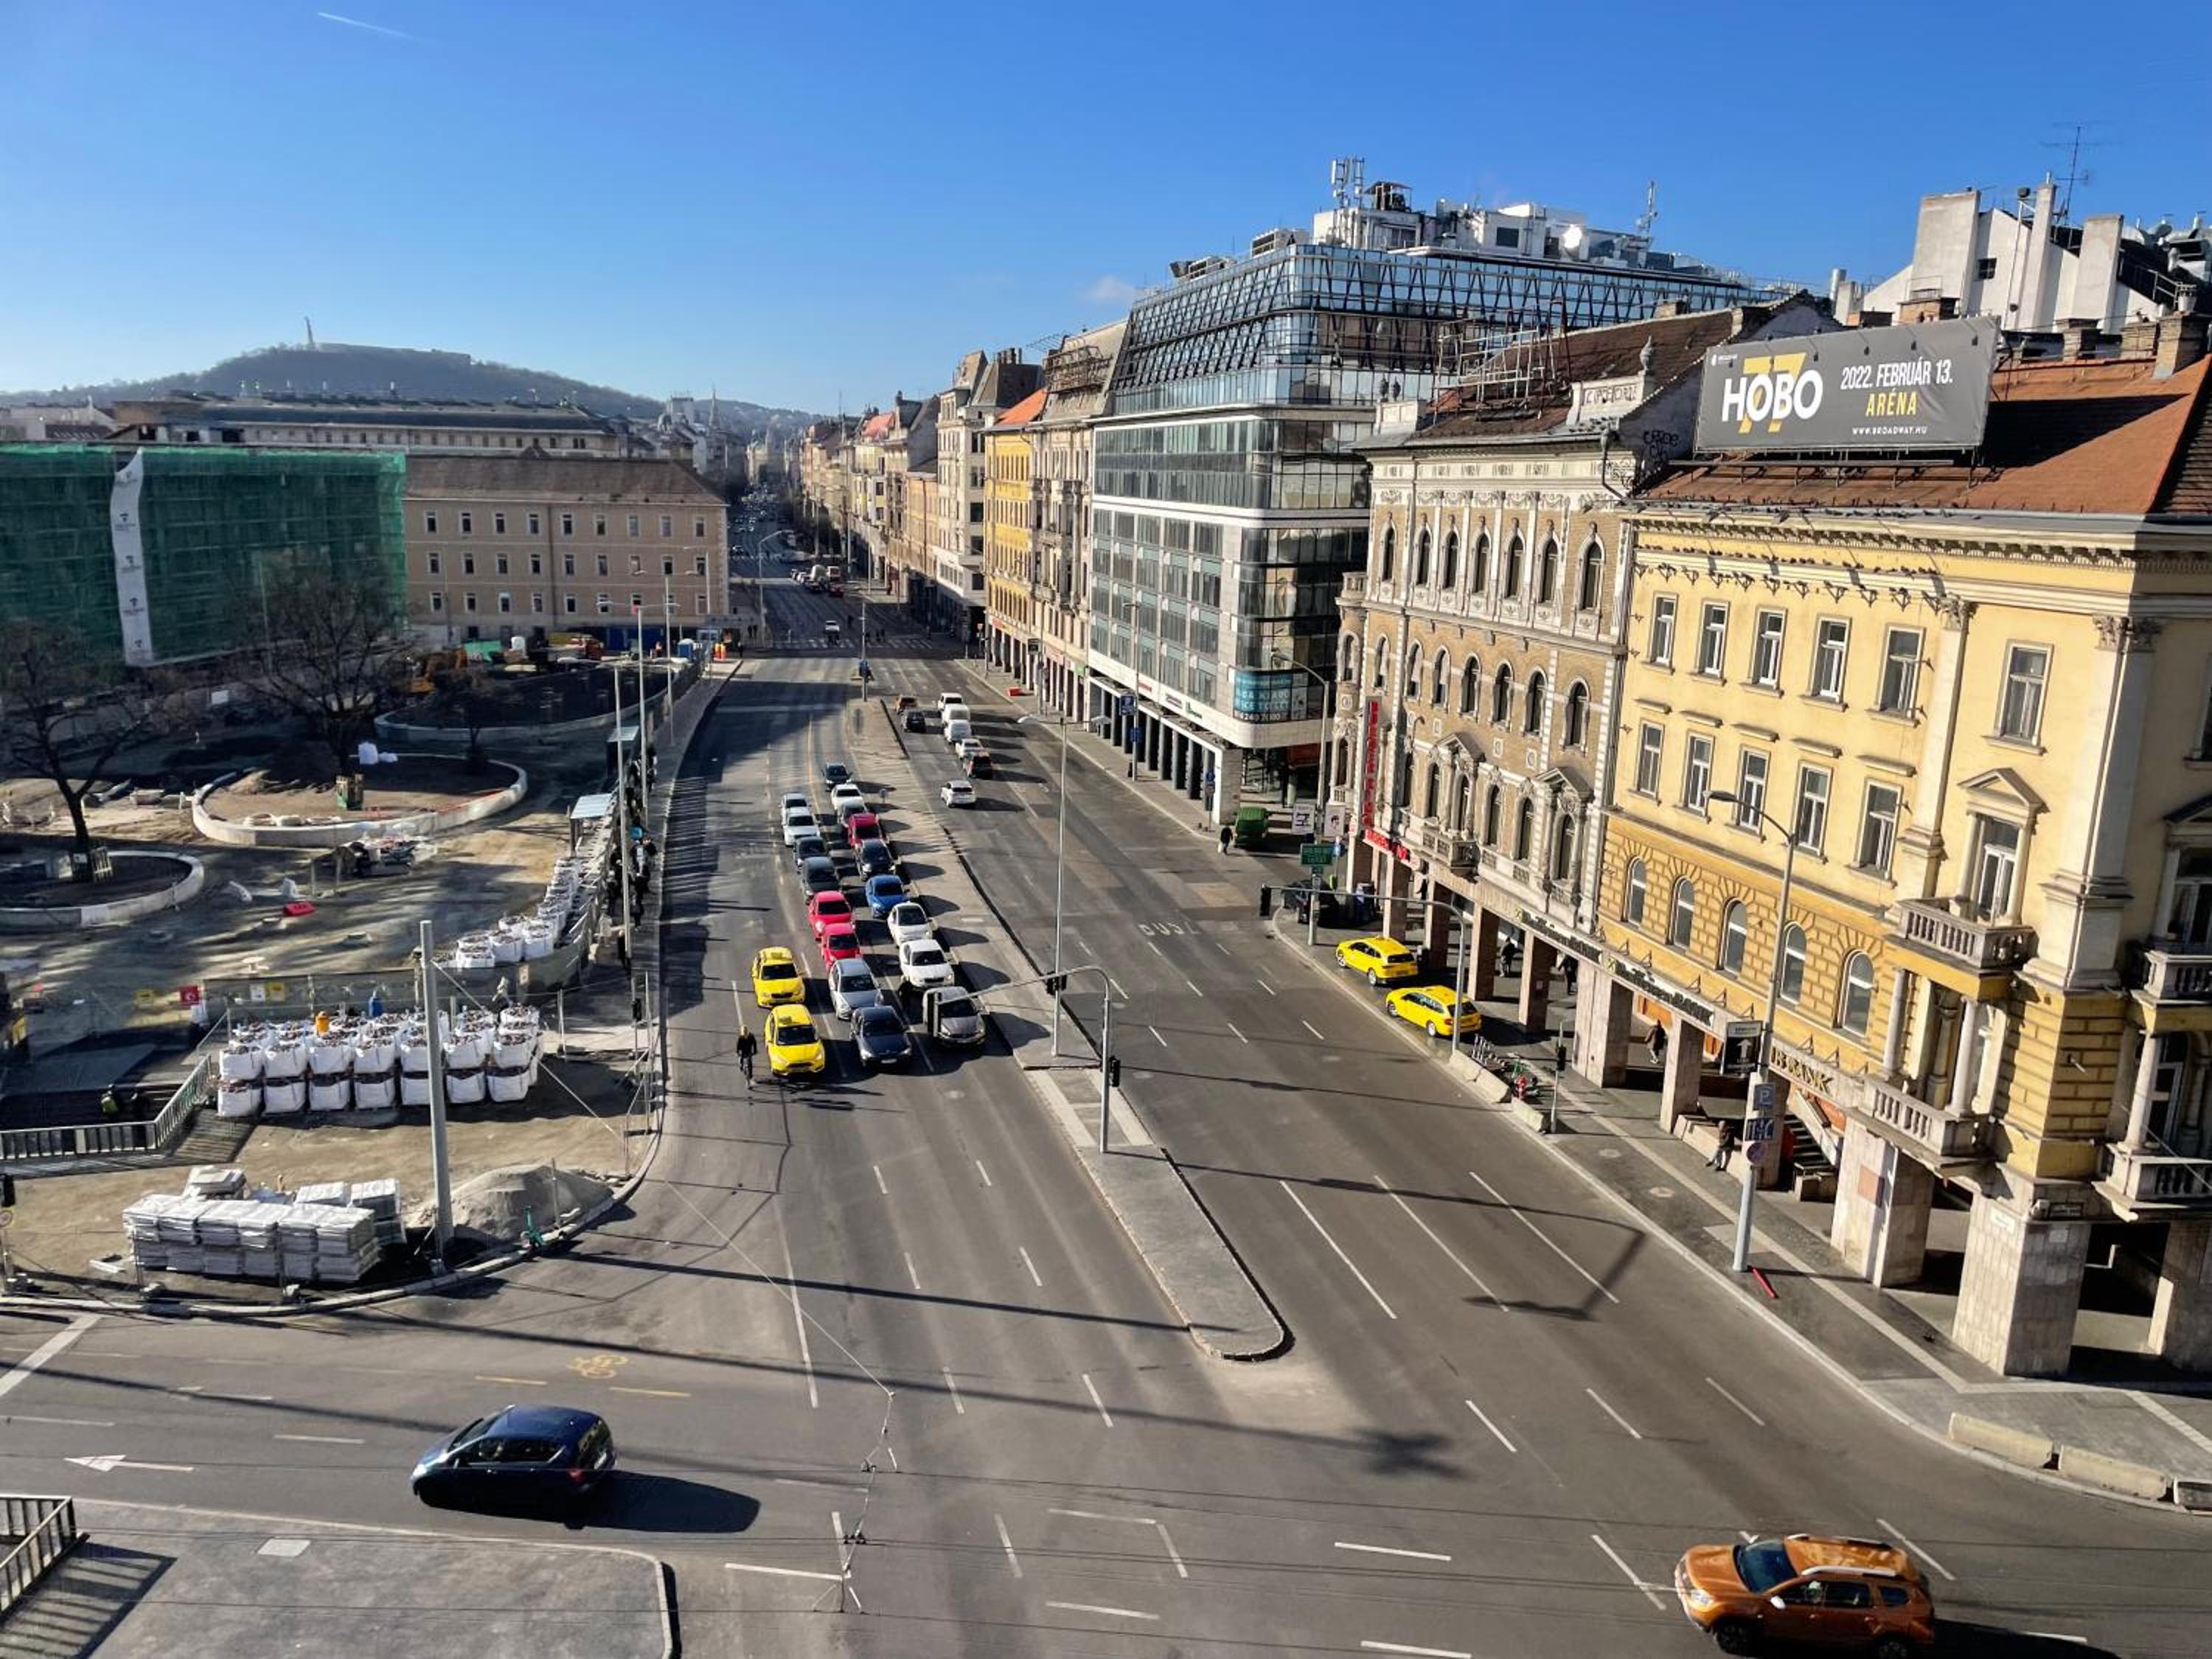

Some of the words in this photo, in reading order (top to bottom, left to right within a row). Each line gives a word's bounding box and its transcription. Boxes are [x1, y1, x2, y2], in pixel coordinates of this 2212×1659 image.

[1840, 364, 1873, 390] 2022.
[1876, 356, 1932, 387] FEBRUÁR
[1935, 359, 1953, 384] 13.
[1722, 369, 1823, 422] HOBO
[1865, 388, 1918, 417] ARÉNA
[1852, 425, 1928, 435] WWW.BROADWAY.HU
[1787, 1051, 1834, 1095] BANK
[1759, 1091, 1771, 1105] P
